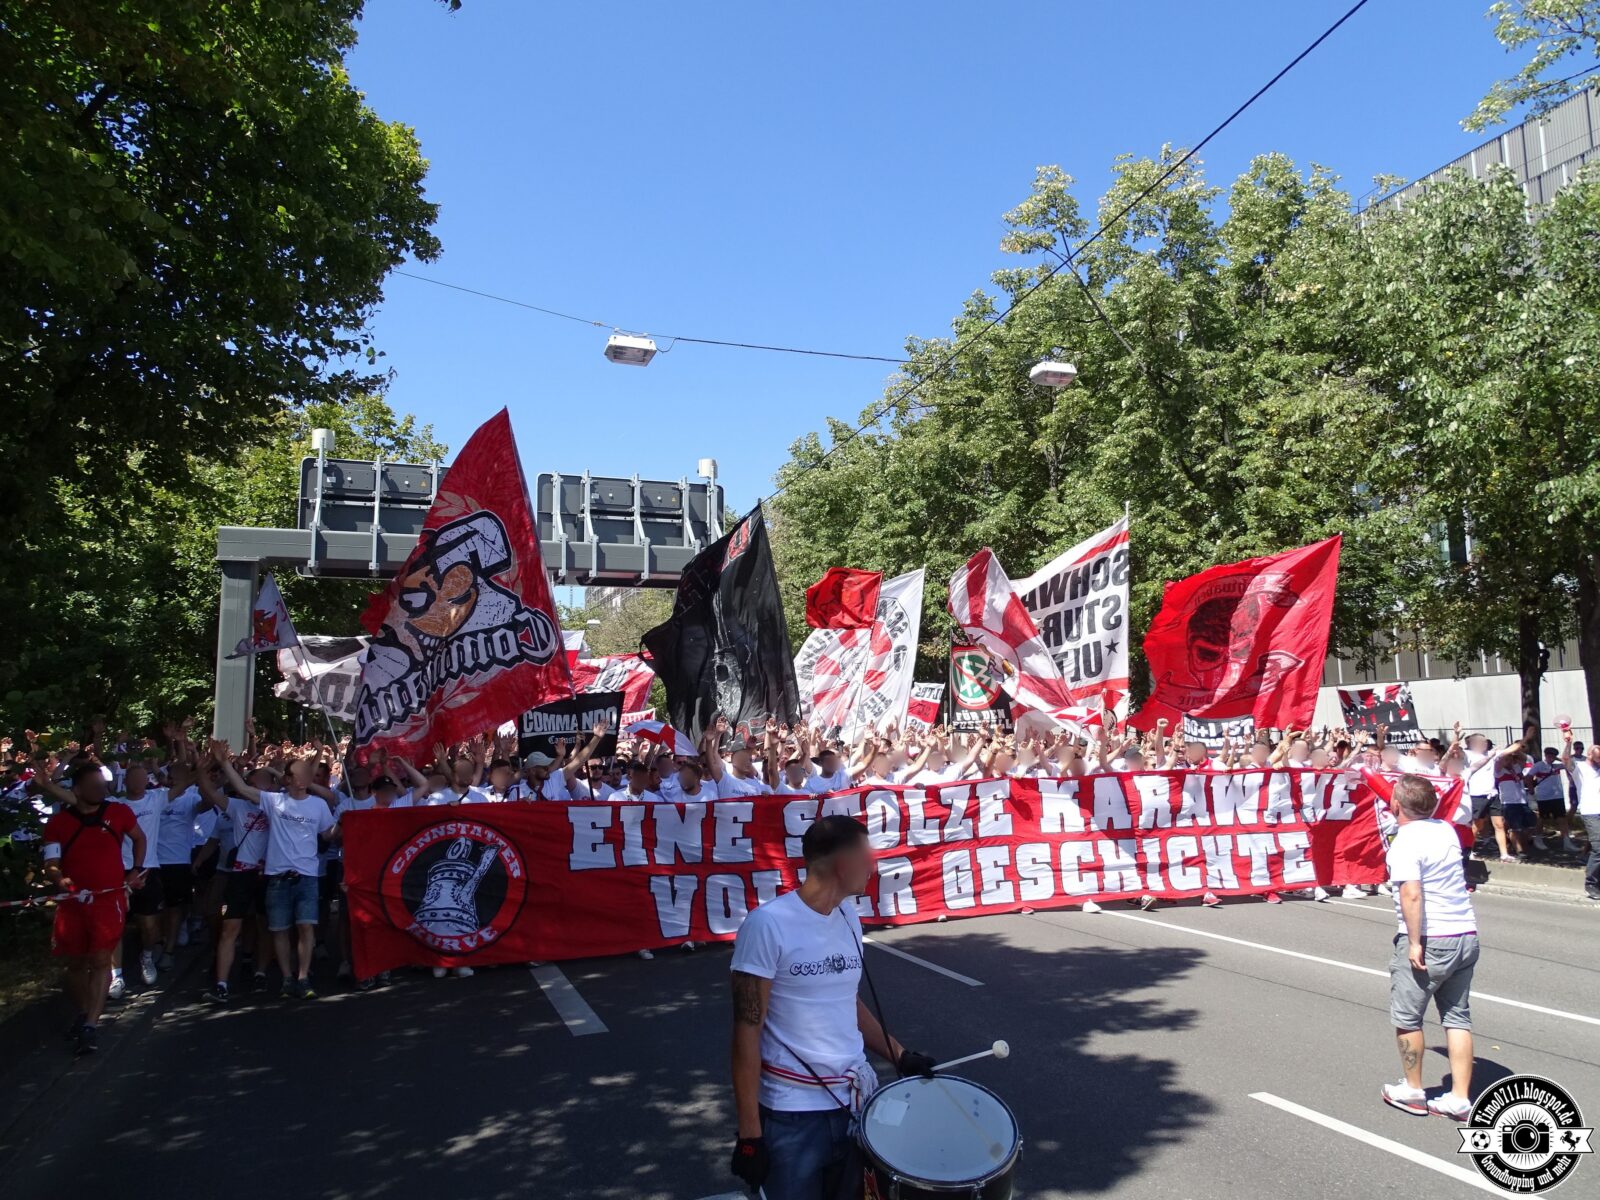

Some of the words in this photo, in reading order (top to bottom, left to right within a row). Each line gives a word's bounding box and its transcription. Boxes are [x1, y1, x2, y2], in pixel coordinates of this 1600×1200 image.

[523, 706, 617, 732] COMMANDO
[956, 709, 979, 721] FÜR
[981, 708, 1006, 720] DEN
[568, 801, 754, 871] EINE
[1038, 771, 1358, 833] KARAWANE
[391, 822, 521, 879] CANNSTATTER
[941, 831, 1317, 910] GESCHICHTE
[405, 921, 498, 951] KURVE
